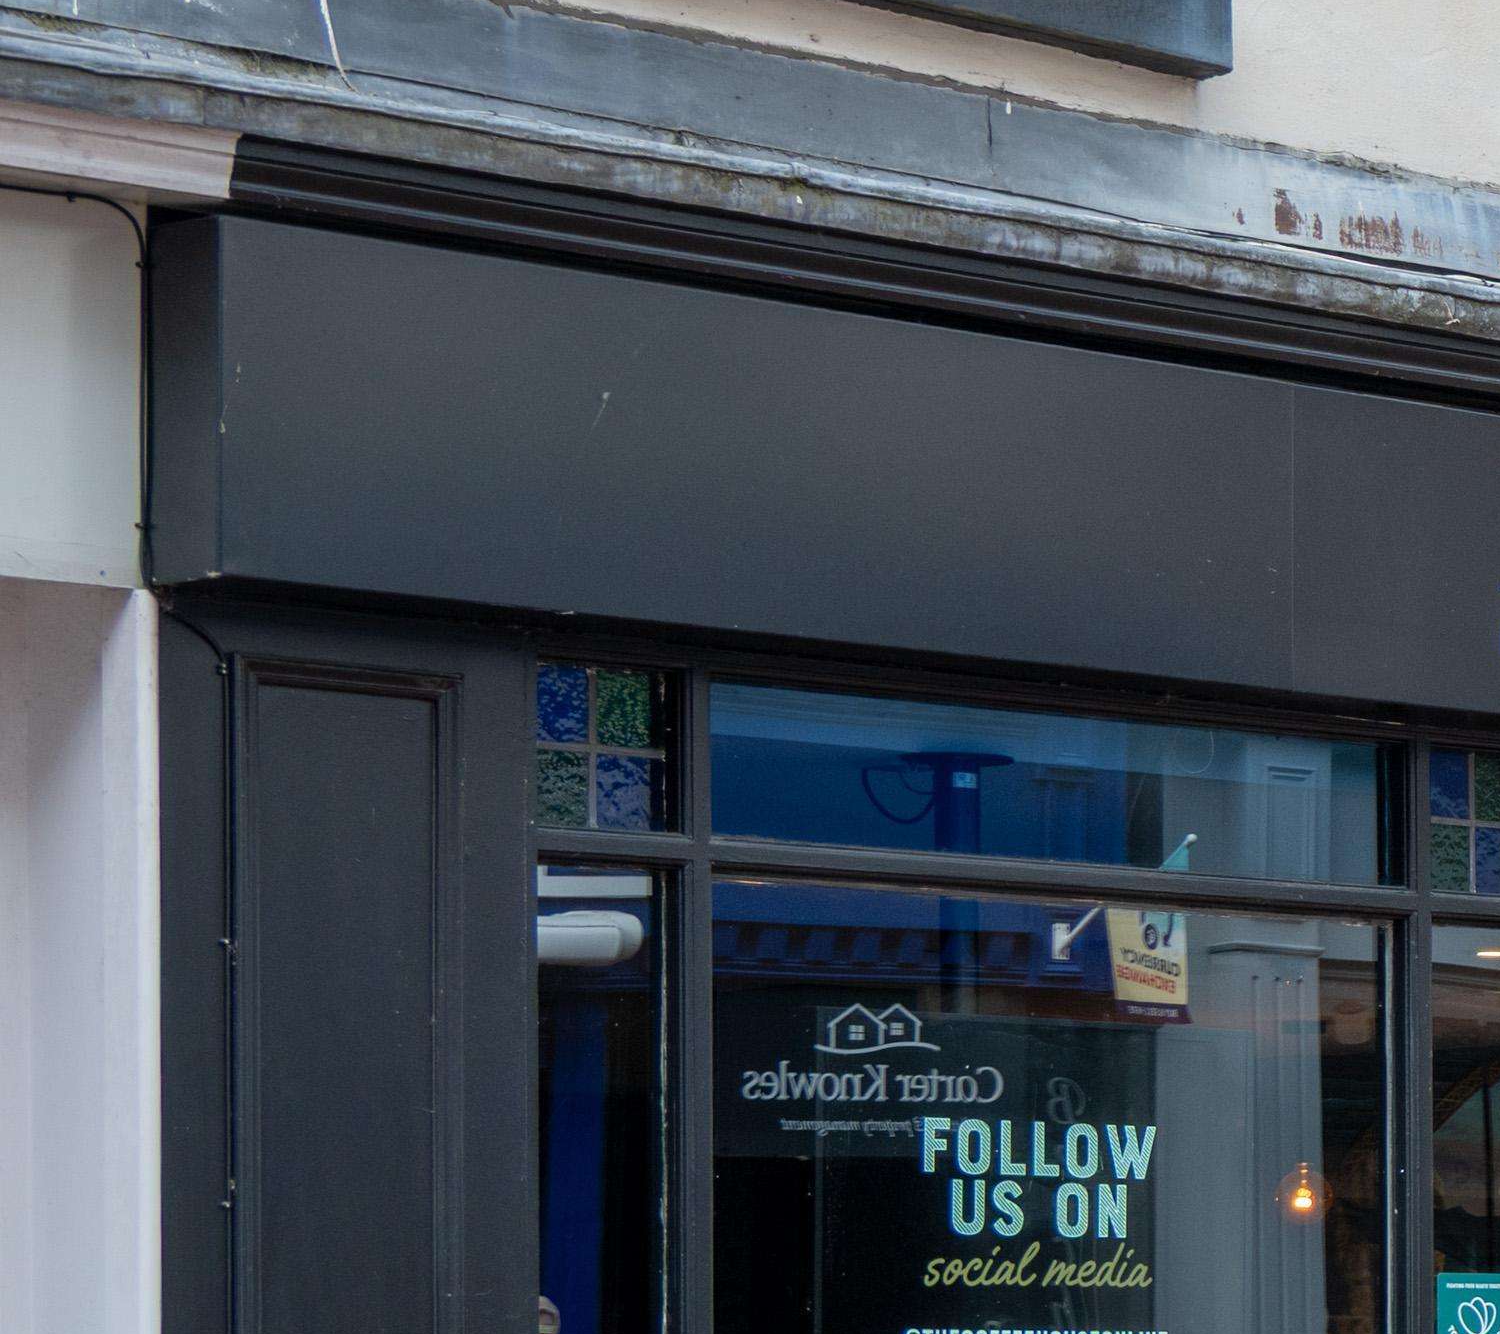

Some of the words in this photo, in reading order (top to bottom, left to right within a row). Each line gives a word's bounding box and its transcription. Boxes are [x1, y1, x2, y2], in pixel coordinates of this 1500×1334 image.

[922, 1117, 1157, 1180] FOLLOW
[950, 1179, 1025, 1237] US
[1055, 1182, 1128, 1239] ON
[923, 1241, 1040, 1288] social
[1041, 1242, 1153, 1288] media
